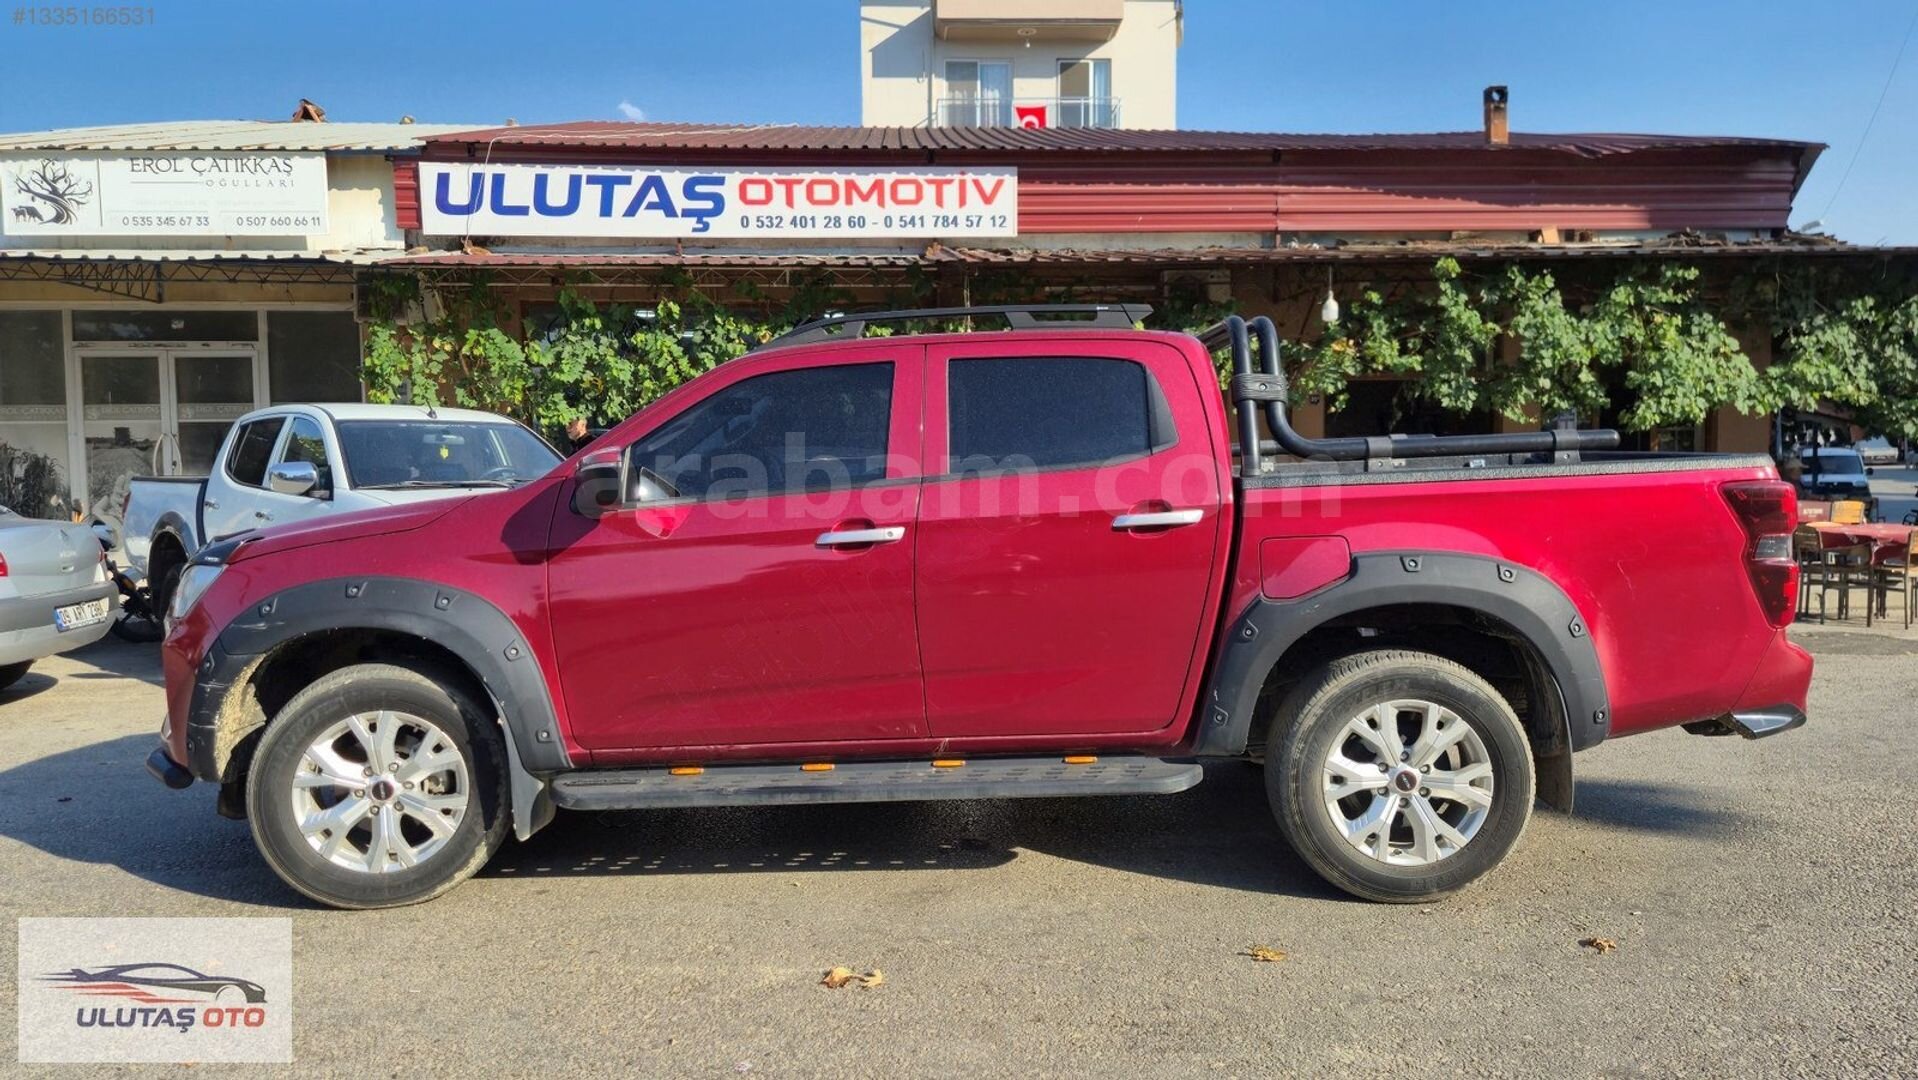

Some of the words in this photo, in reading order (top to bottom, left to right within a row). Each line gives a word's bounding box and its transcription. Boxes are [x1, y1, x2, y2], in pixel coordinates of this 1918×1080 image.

[130, 158, 184, 174] EROL
[191, 158, 293, 176] ÇATIKKAŞ
[205, 179, 295, 188] OĞULLARI
[435, 172, 726, 232] ULUTAŞ
[738, 171, 1005, 209] OTOMOTİV
[122, 216, 130, 226] 0
[133, 216, 153, 226] 535
[156, 216, 177, 226] 345
[179, 216, 192, 226] 67
[196, 216, 210, 226] 33
[236, 216, 244, 226] 0
[246, 216, 266, 226] 507
[270, 216, 291, 226] 660
[294, 216, 308, 226] 66
[311, 216, 321, 226] 11
[740, 215, 750, 229] 0
[755, 215, 784, 229] 532
[789, 215, 816, 229] 401
[823, 215, 842, 229] 28
[848, 215, 866, 229] 60
[884, 215, 893, 229] 0
[899, 215, 925, 229] 541
[932, 215, 959, 229] 784
[965, 215, 983, 229] 57
[990, 215, 1007, 229] 12
